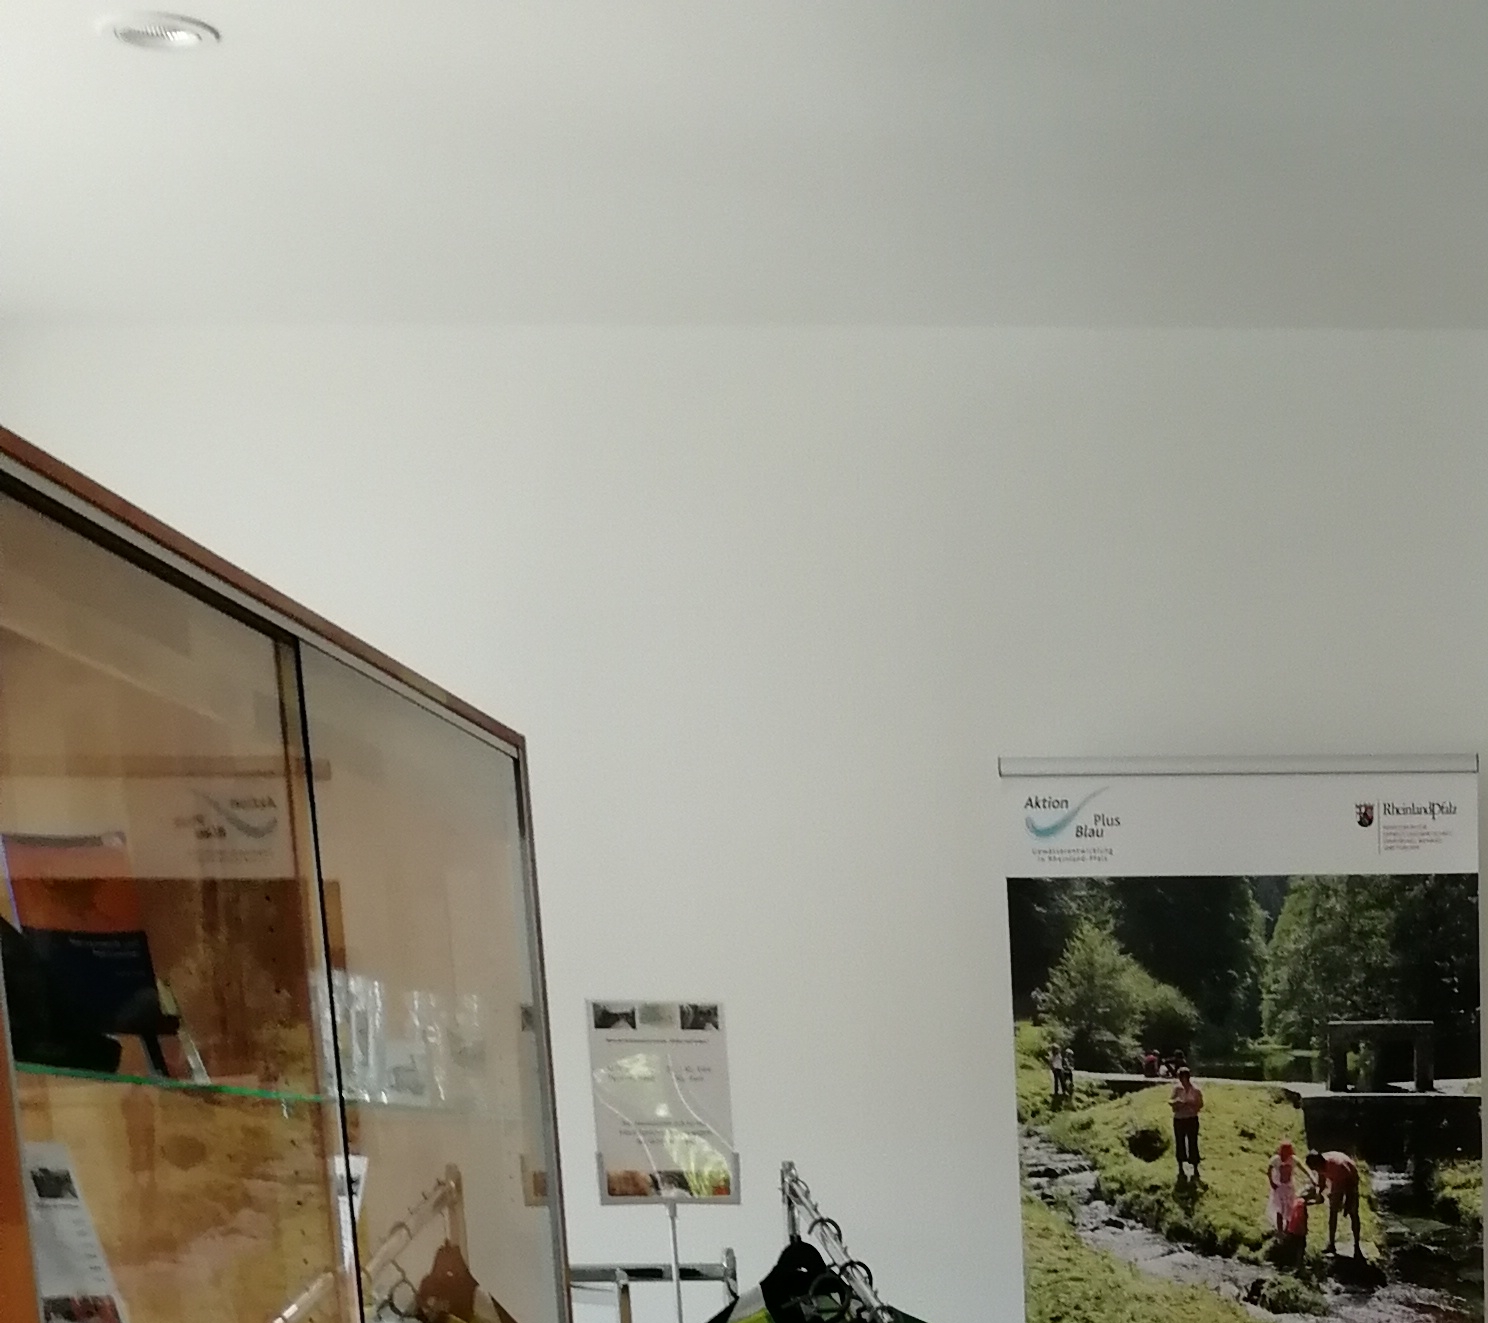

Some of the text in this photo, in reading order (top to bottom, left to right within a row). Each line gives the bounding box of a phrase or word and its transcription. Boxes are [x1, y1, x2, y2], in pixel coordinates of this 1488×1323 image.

[1024, 796, 1069, 809] Aktion
[1094, 813, 1120, 826] Plus
[1075, 825, 1104, 838] Blau
